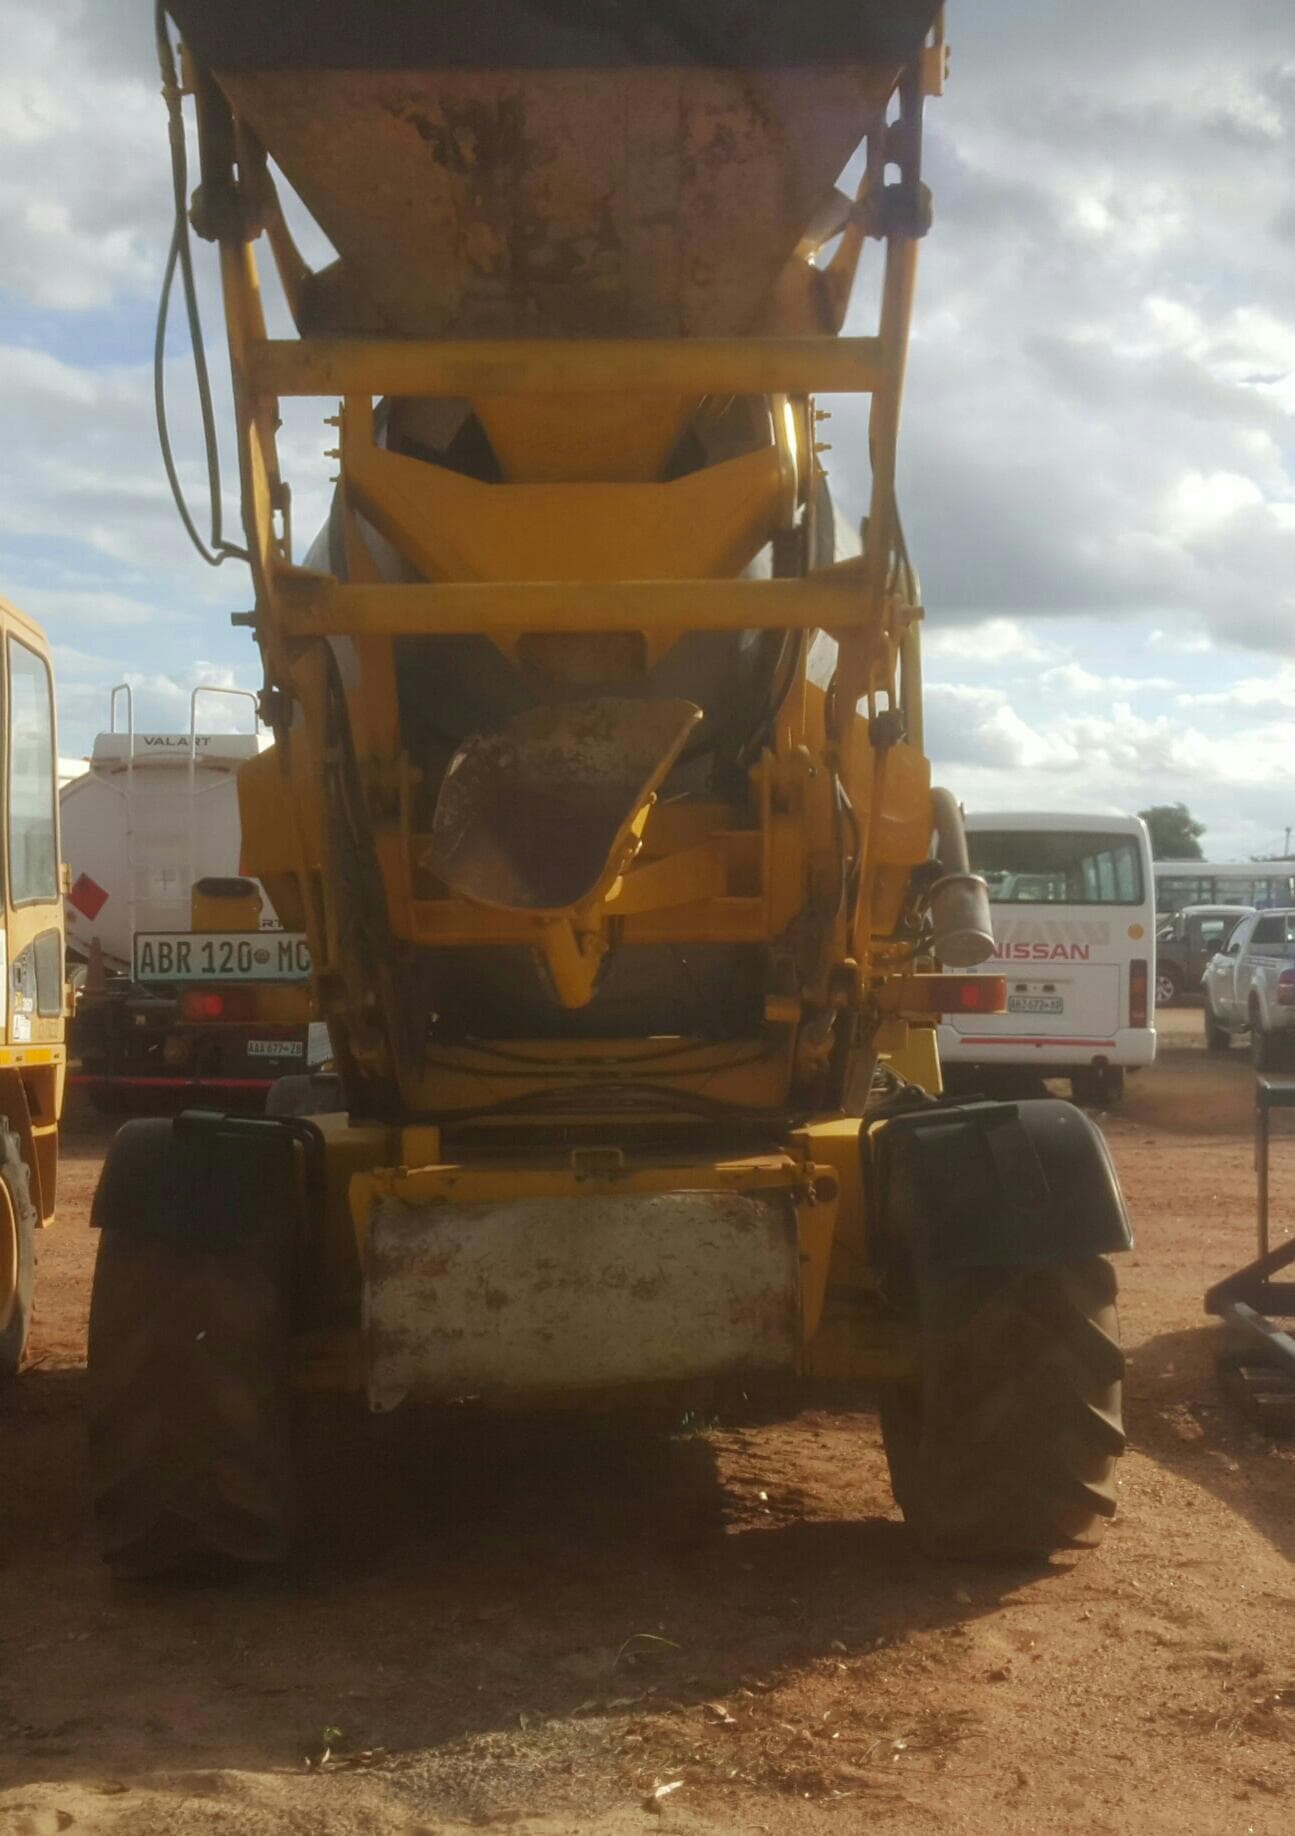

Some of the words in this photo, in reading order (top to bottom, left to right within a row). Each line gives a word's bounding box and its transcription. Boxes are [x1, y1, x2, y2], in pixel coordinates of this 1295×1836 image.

[140, 941, 192, 974] ABR
[201, 941, 253, 974] 120
[991, 942, 1090, 960] NISSAN
